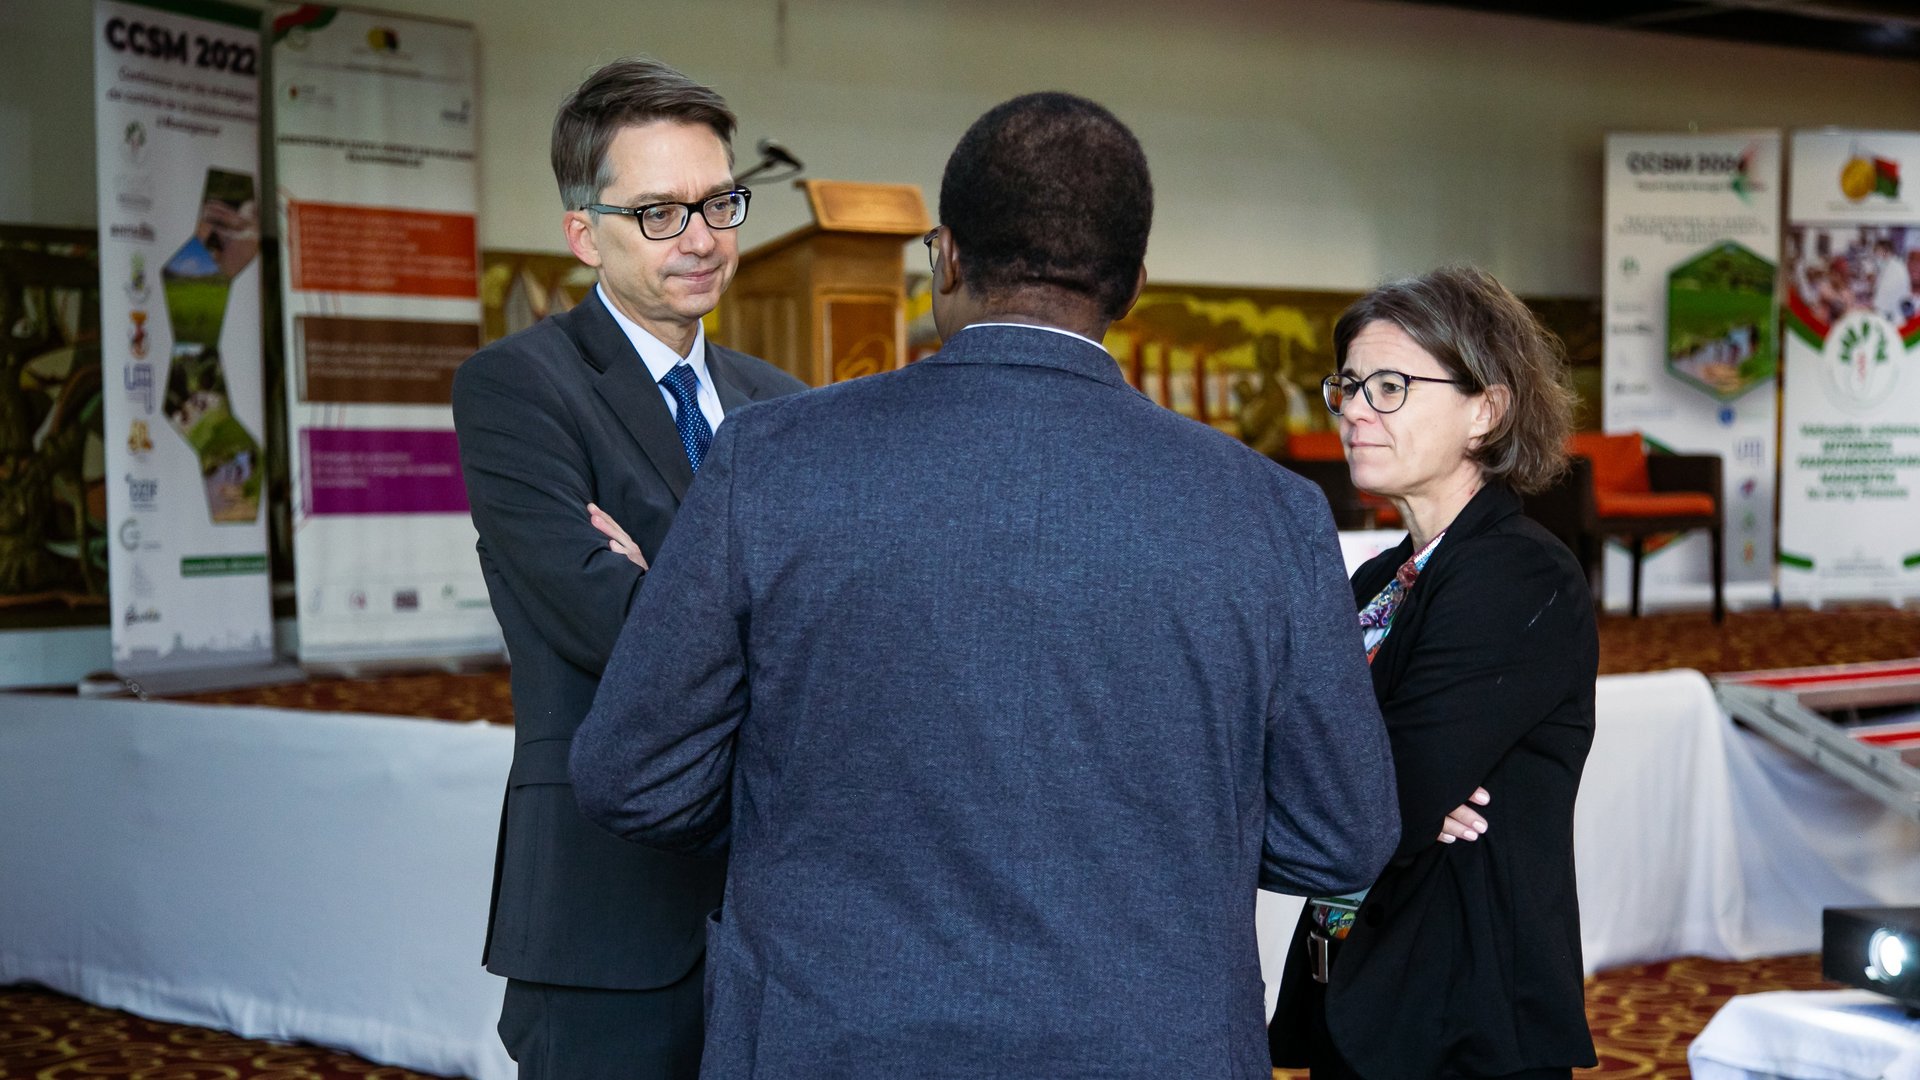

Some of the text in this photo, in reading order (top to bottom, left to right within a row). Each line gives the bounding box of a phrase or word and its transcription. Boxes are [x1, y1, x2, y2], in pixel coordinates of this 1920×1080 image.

[105, 17, 188, 66] CCSM
[195, 34, 257, 78] 2022
[1626, 151, 1692, 175] CCSM
